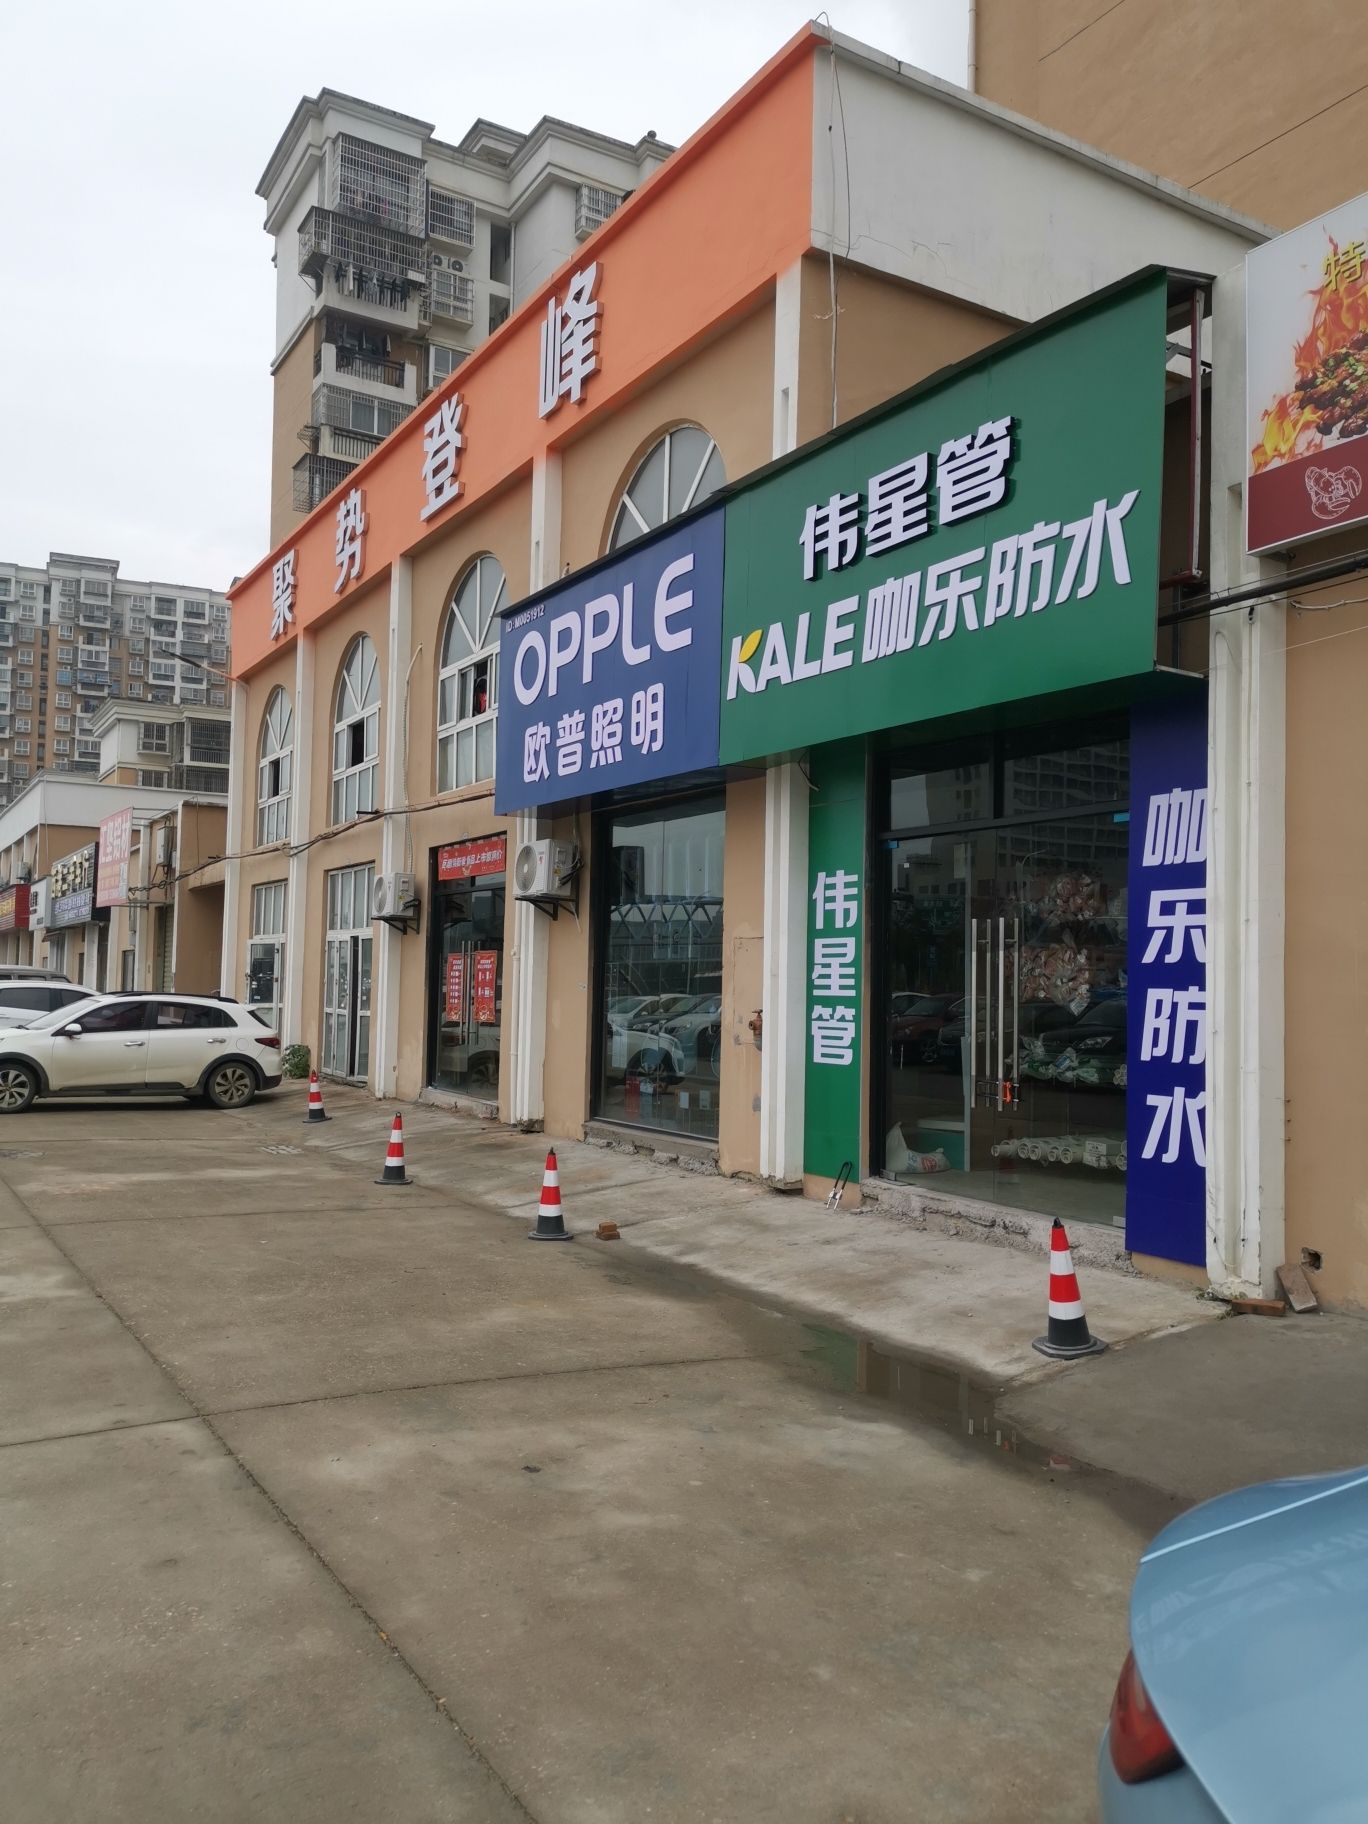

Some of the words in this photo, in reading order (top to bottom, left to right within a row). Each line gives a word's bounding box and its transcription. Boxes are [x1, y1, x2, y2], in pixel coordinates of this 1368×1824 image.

[1323, 239, 1367, 291] 特
[270, 260, 604, 642] 聚势登峰
[799, 415, 1018, 581] 伟星管
[513, 552, 695, 707] OPPLE
[726, 594, 860, 702] KALE
[861, 488, 1142, 664] 咖乐防水
[523, 682, 665, 784] 欧普照明
[811, 869, 859, 1067] 伟星管
